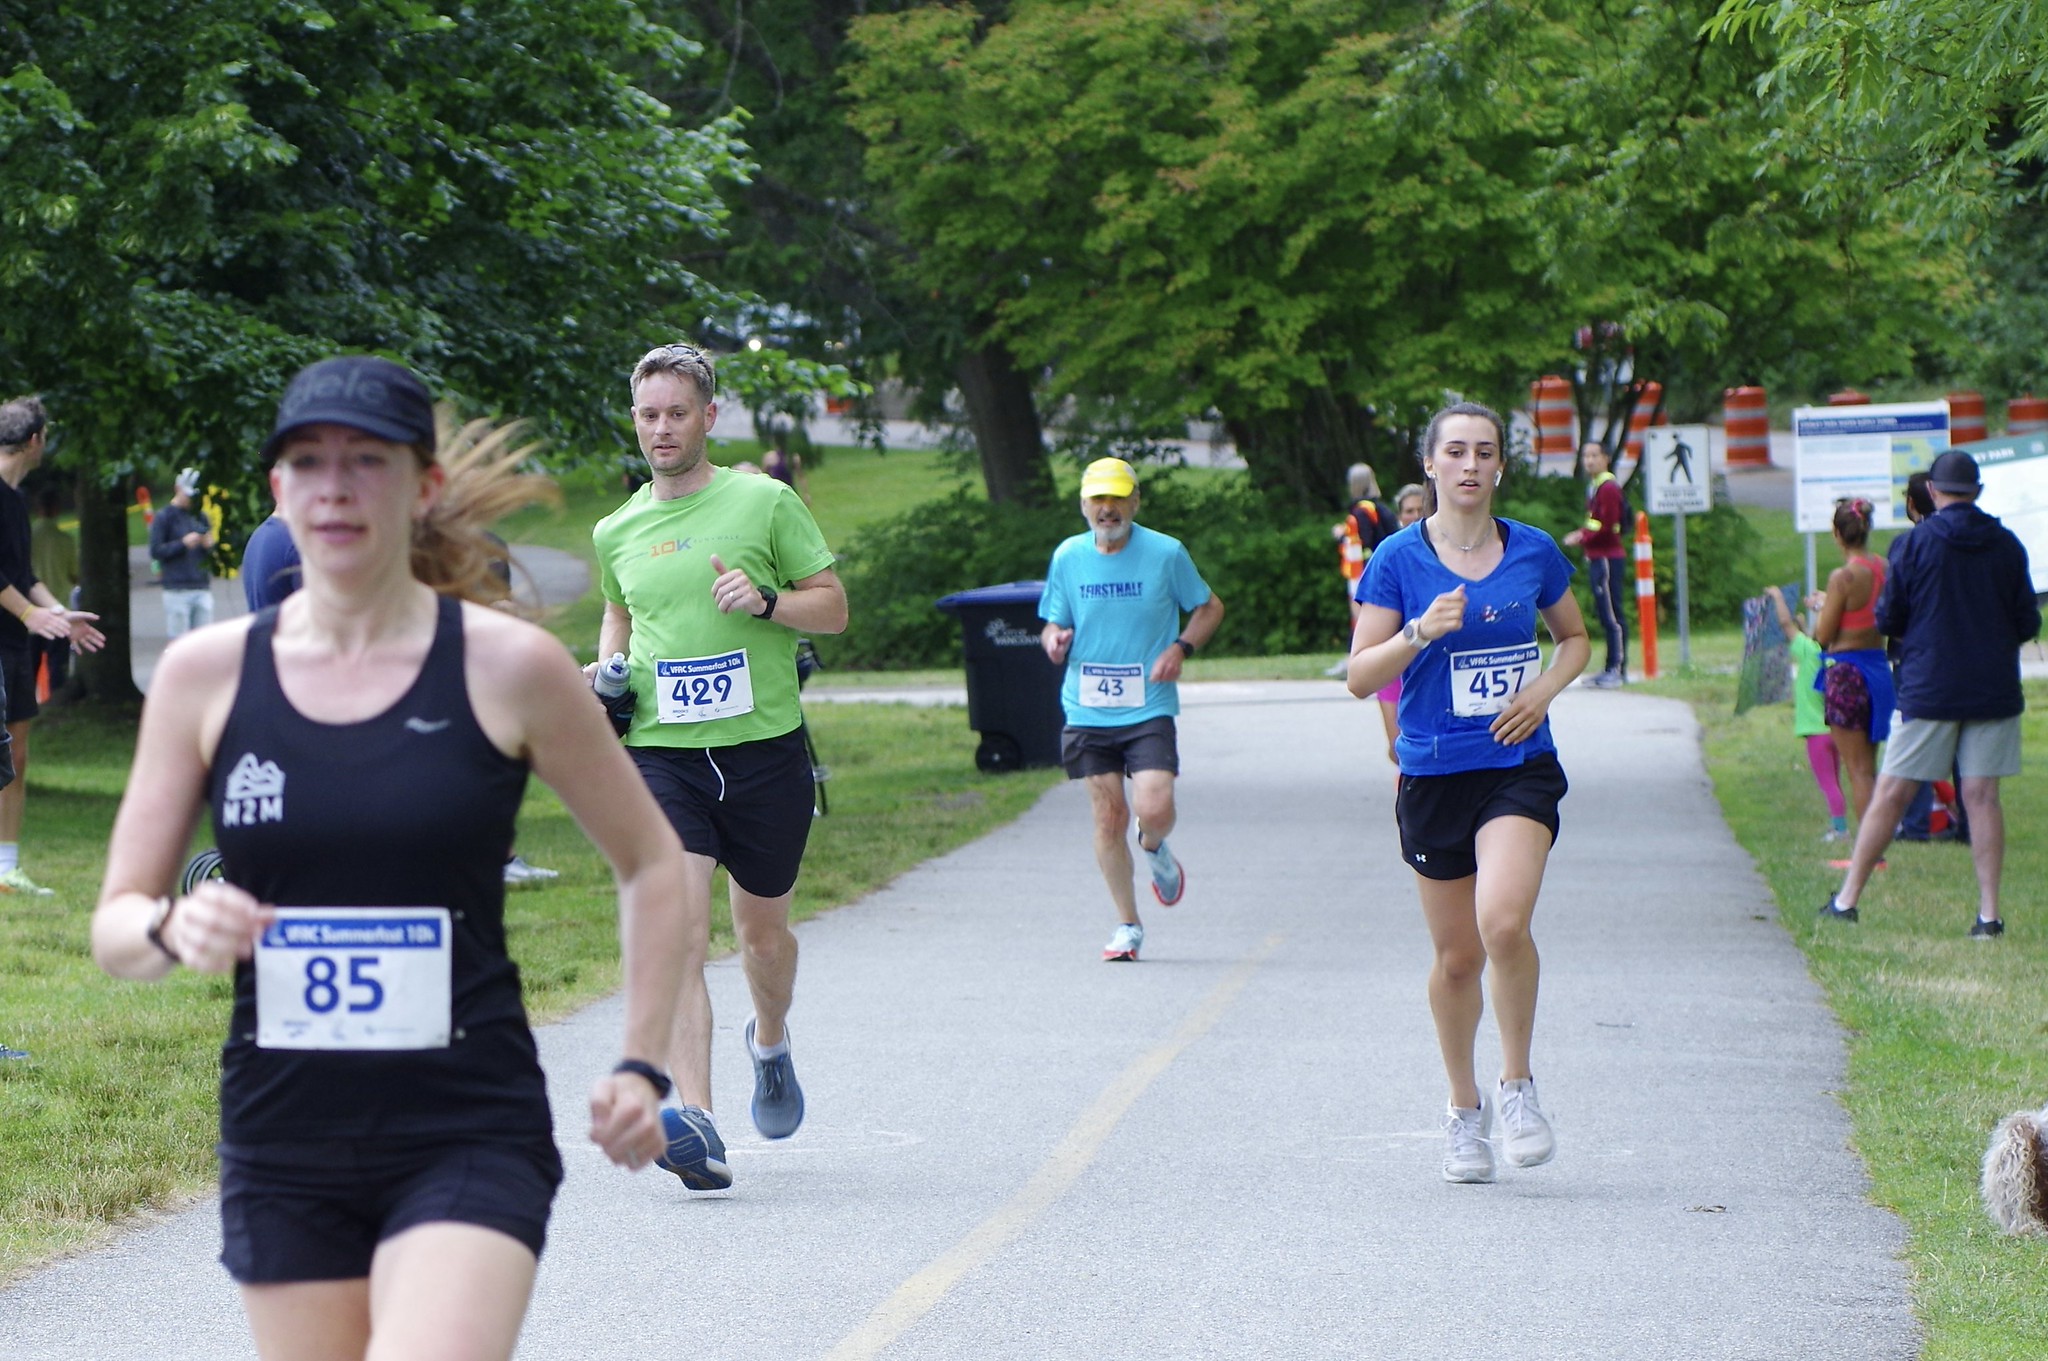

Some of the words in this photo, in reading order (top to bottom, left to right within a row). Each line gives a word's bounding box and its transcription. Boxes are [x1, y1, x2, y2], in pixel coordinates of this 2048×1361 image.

[651, 537, 692, 557] 10K
[672, 674, 732, 706] 429
[1098, 679, 1123, 696] 43
[1469, 666, 1525, 698] 457
[222, 795, 283, 828] M2M
[304, 956, 384, 1014] 85
